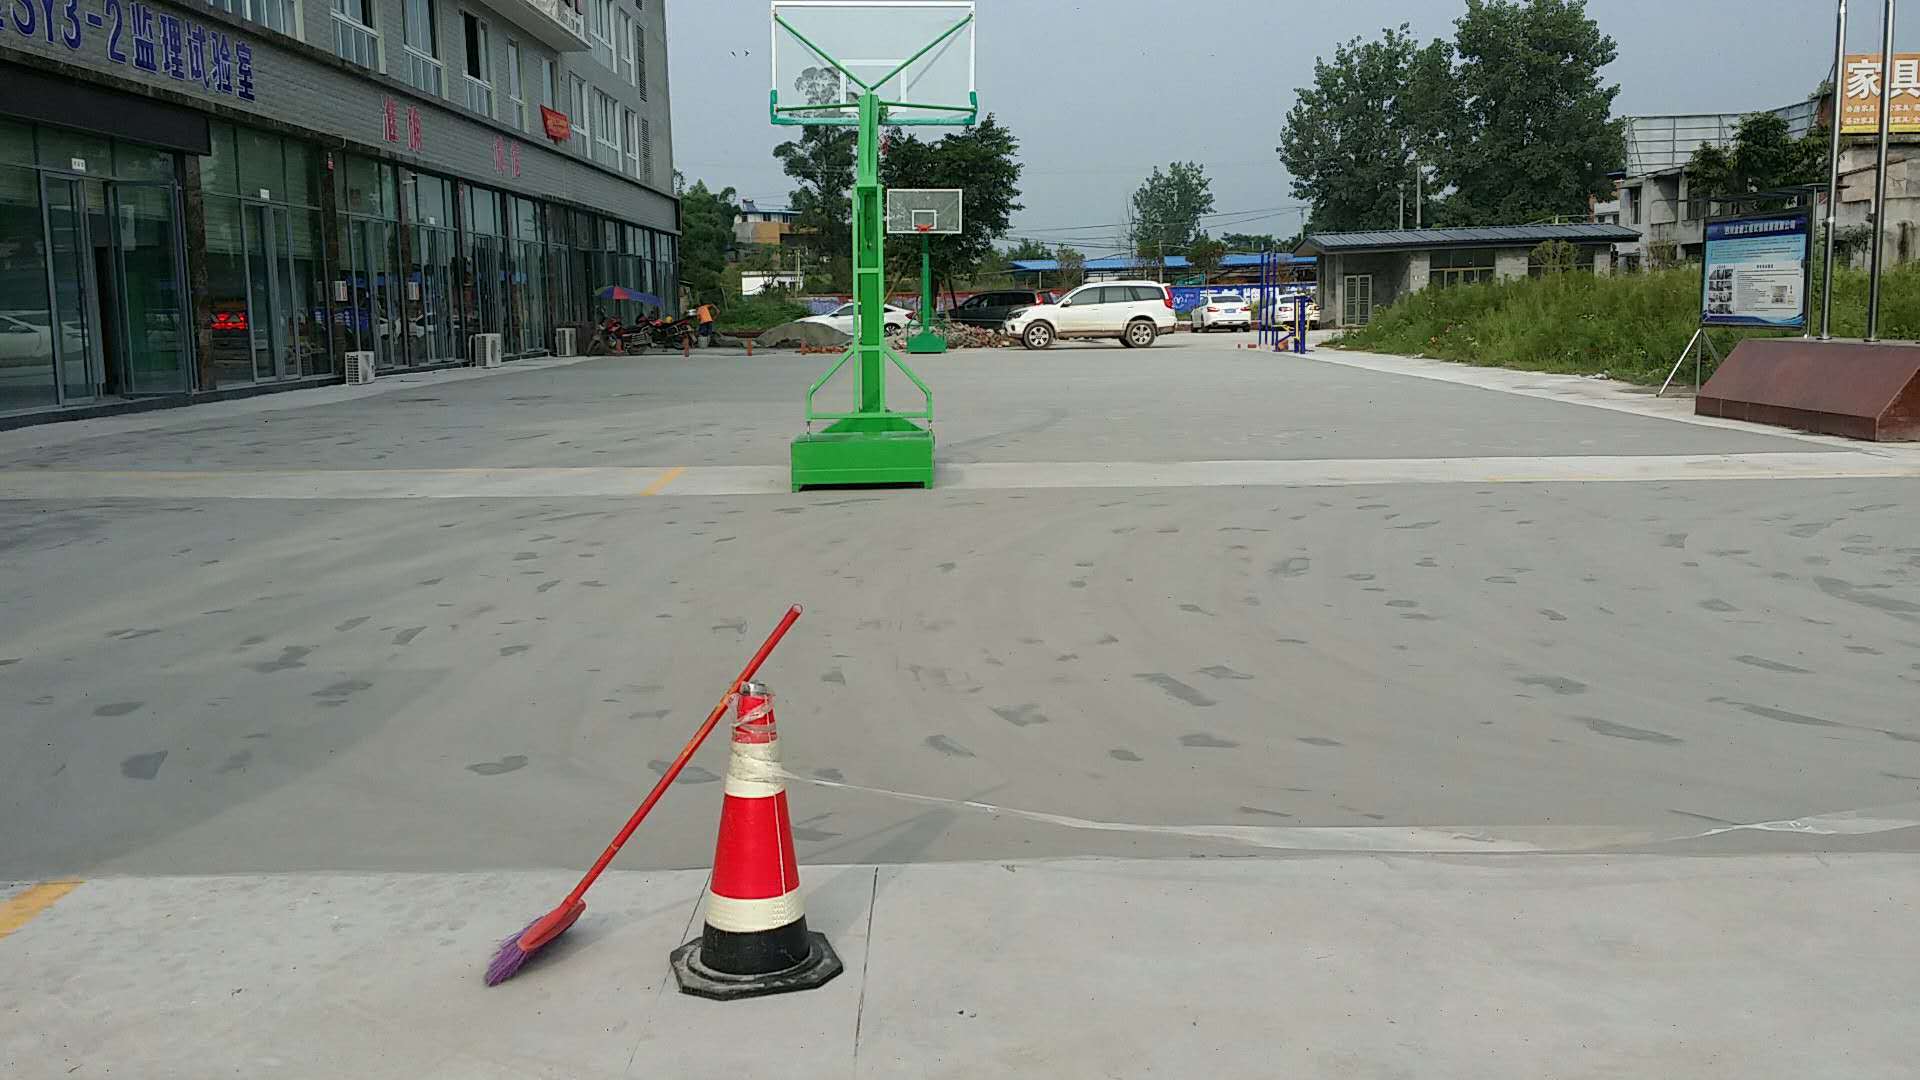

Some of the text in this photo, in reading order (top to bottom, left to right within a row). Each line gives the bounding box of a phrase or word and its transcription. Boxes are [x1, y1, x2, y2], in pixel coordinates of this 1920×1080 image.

[0, 0, 256, 102] SY3-2监理试验室
[1847, 59, 1920, 99] 家具
